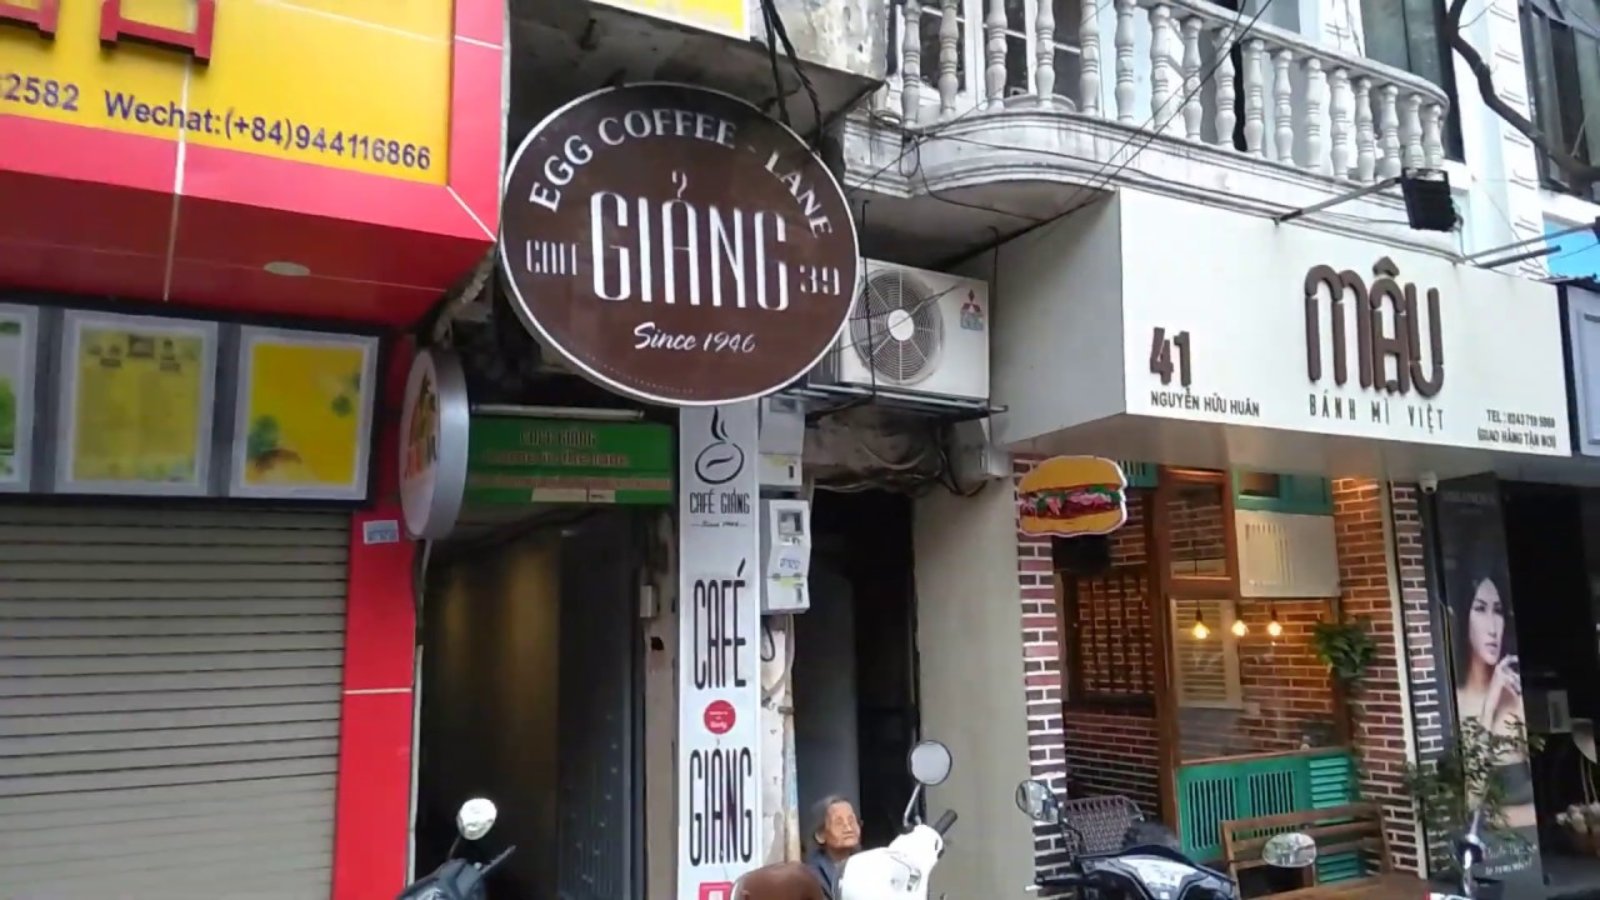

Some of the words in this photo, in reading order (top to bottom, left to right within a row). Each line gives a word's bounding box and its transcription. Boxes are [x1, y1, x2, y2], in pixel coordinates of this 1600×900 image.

[0, 73, 80, 112] 2582
[530, 134, 593, 213] EGG
[598, 109, 737, 149] COFFEE
[765, 150, 833, 239] LANE
[799, 263, 841, 296] 39
[633, 322, 697, 350] Since
[703, 331, 756, 354] 1946
[1149, 327, 1191, 387] 41
[1150, 386, 1200, 410] NGUYỄN
[1309, 389, 1357, 421] BÁNH
[1407, 403, 1443, 434] VIỆT
[693, 557, 747, 690] CAFÉ
